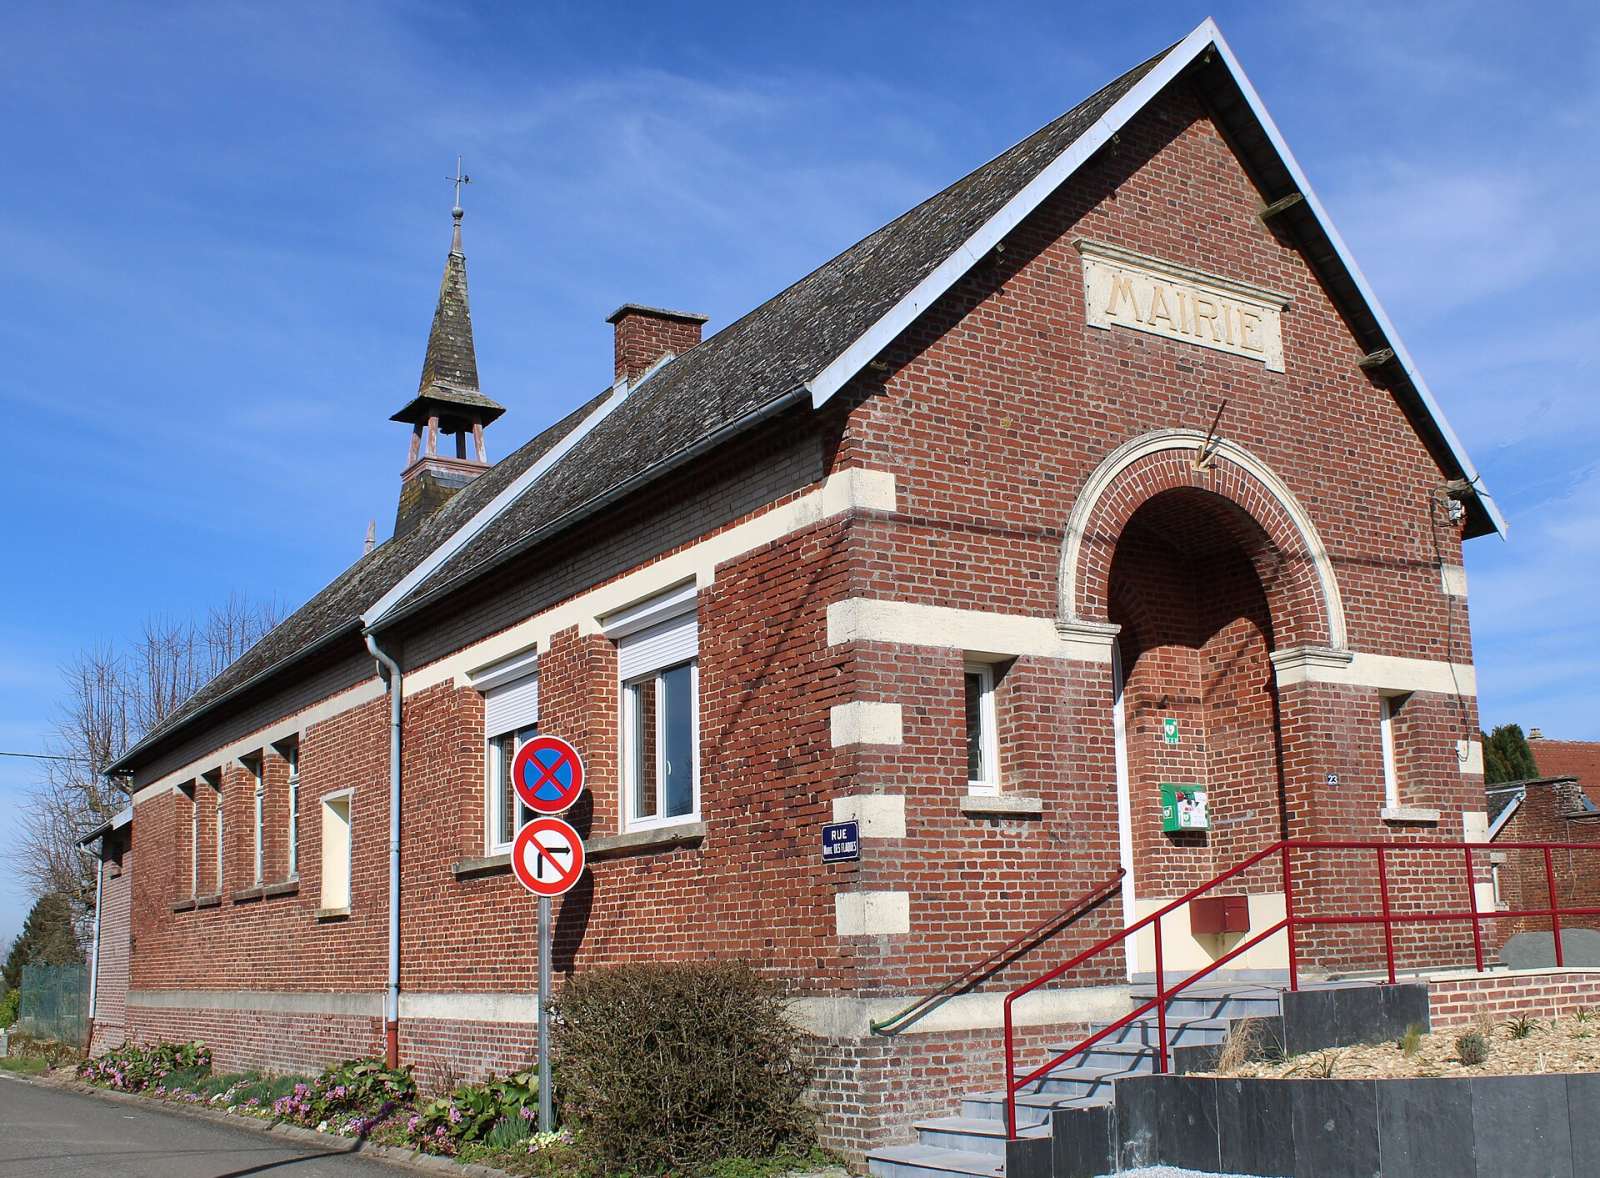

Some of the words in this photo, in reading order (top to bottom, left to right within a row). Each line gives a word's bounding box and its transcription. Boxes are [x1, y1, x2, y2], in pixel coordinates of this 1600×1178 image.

[1105, 274, 1264, 353] MAIRIE
[1327, 774, 1338, 785] 23
[831, 828, 847, 841] RUE
